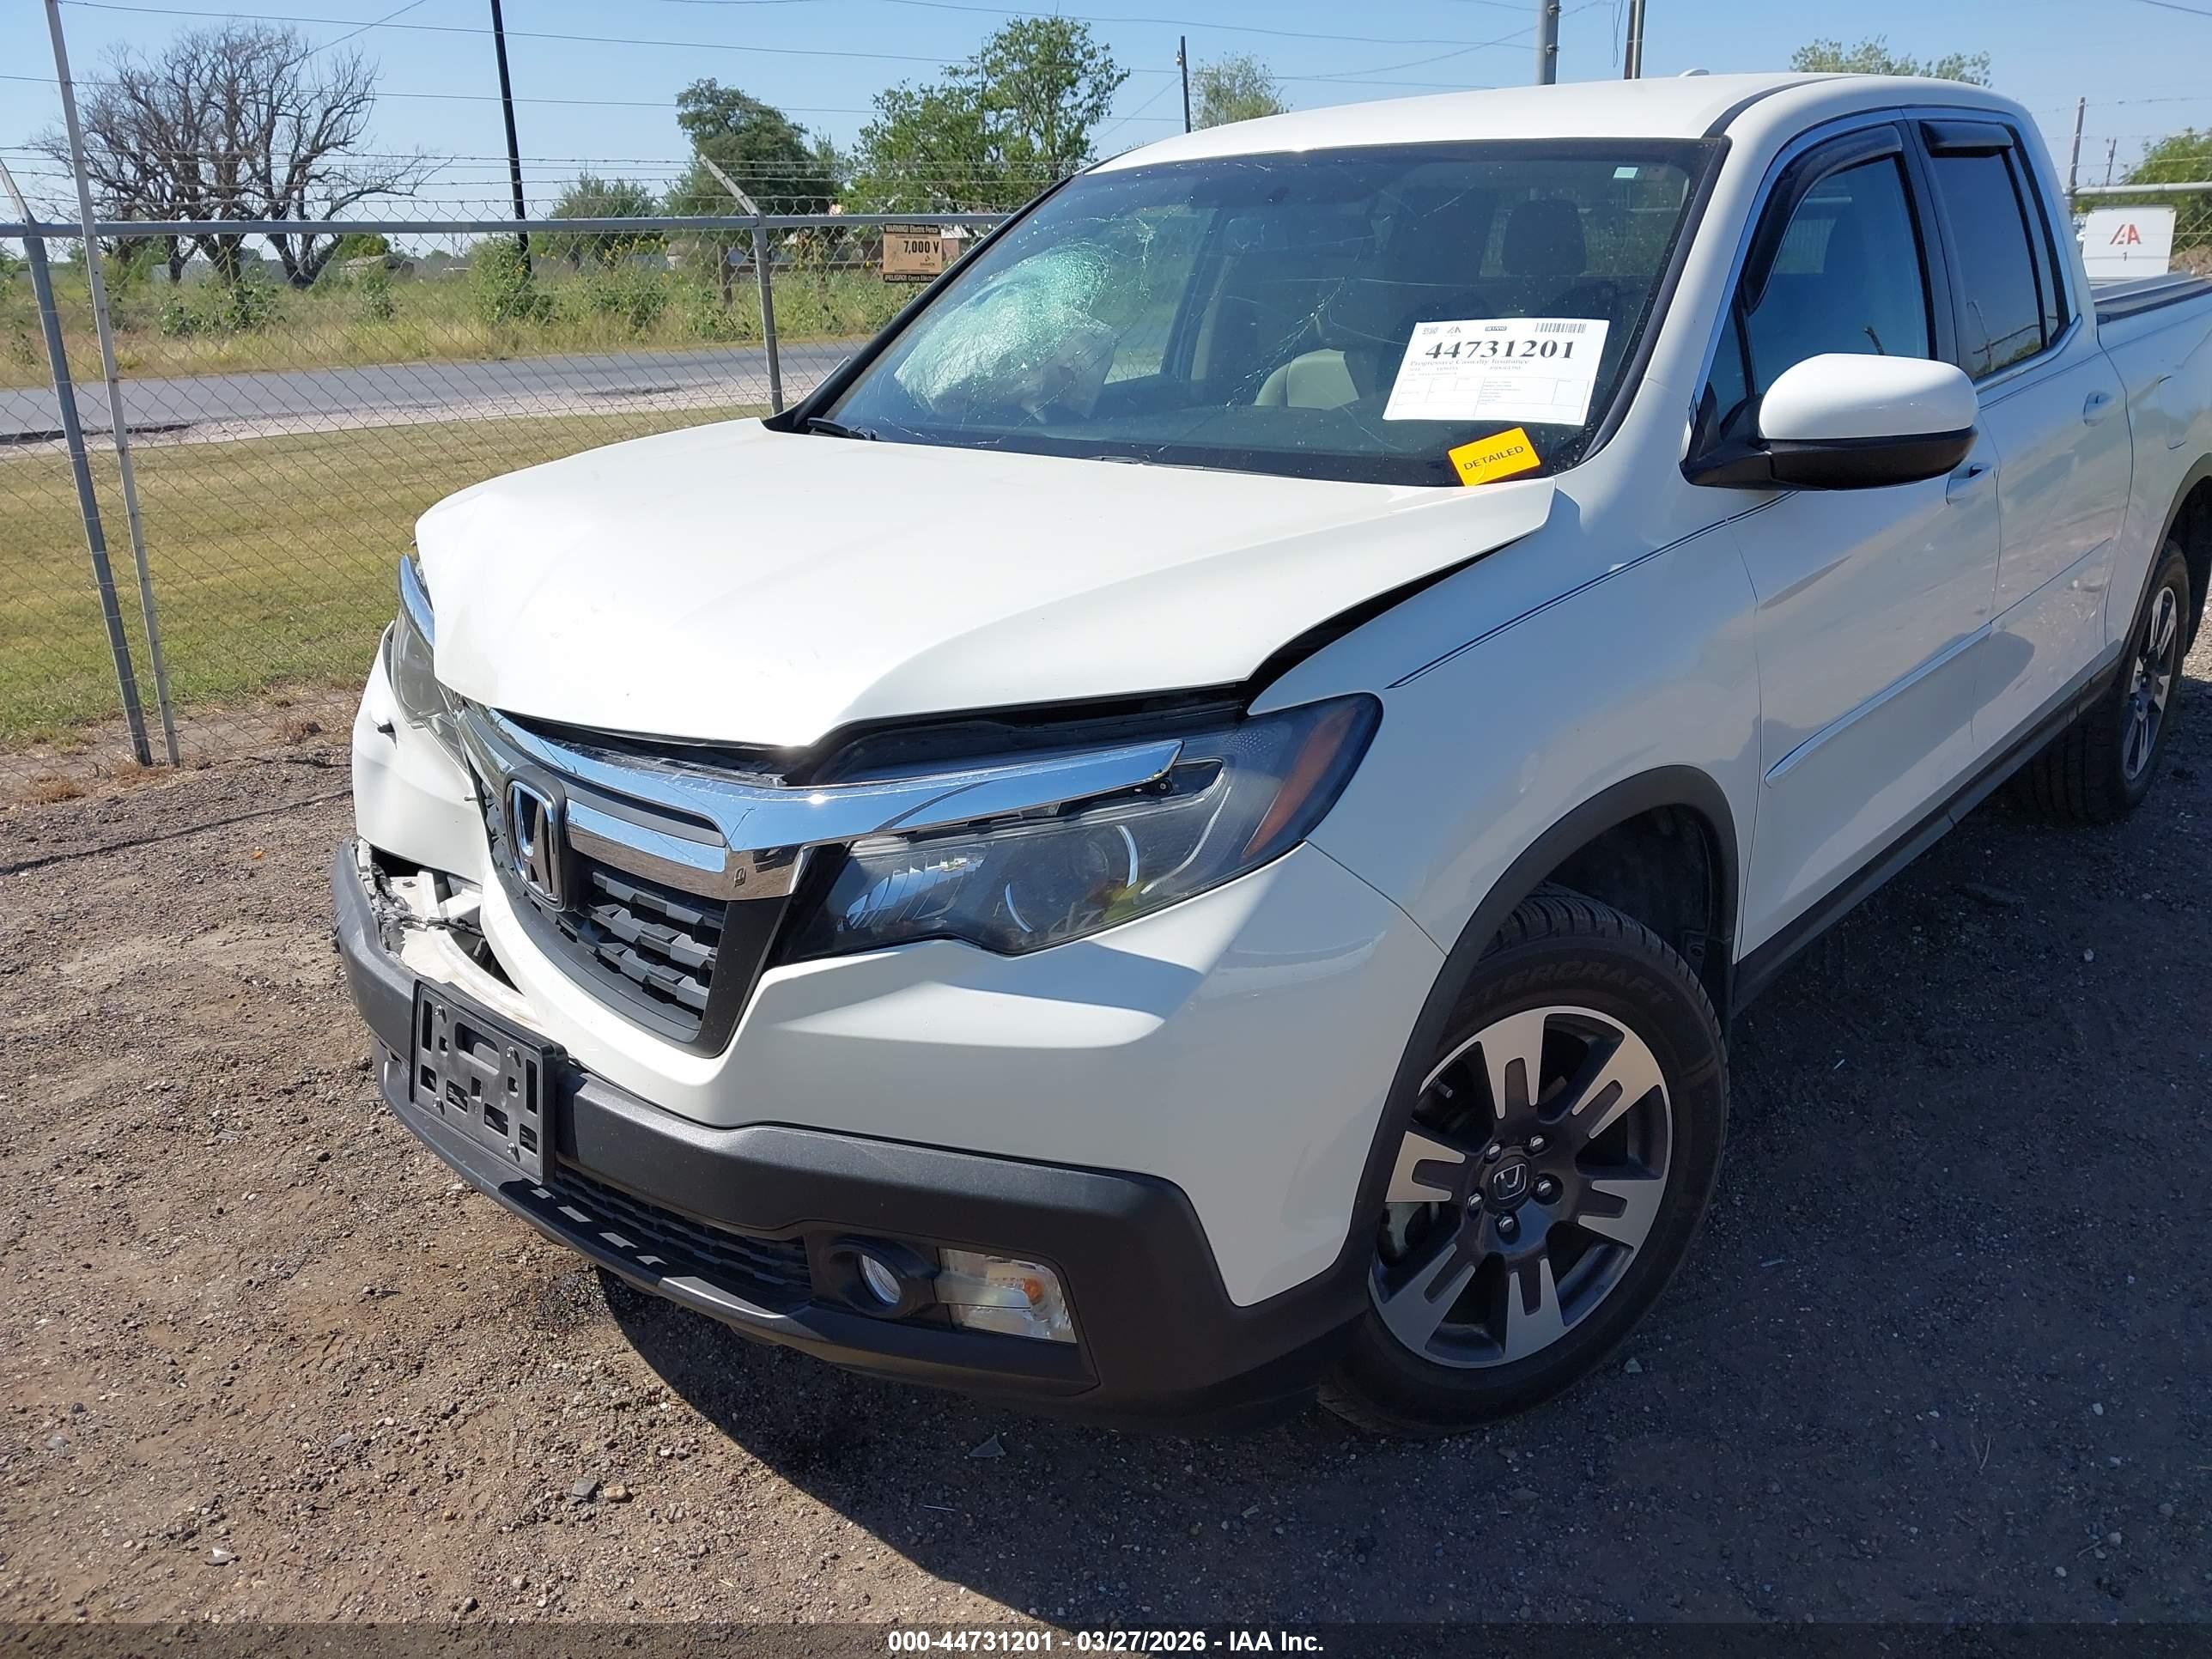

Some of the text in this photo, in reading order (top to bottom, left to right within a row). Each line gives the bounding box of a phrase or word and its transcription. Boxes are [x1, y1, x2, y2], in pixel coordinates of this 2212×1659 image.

[903, 240, 939, 254] 7,000 V
[1425, 339, 1575, 359] 44731201
[1410, 359, 1455, 368] Progressive
[1463, 446, 1524, 471] DETAILED
